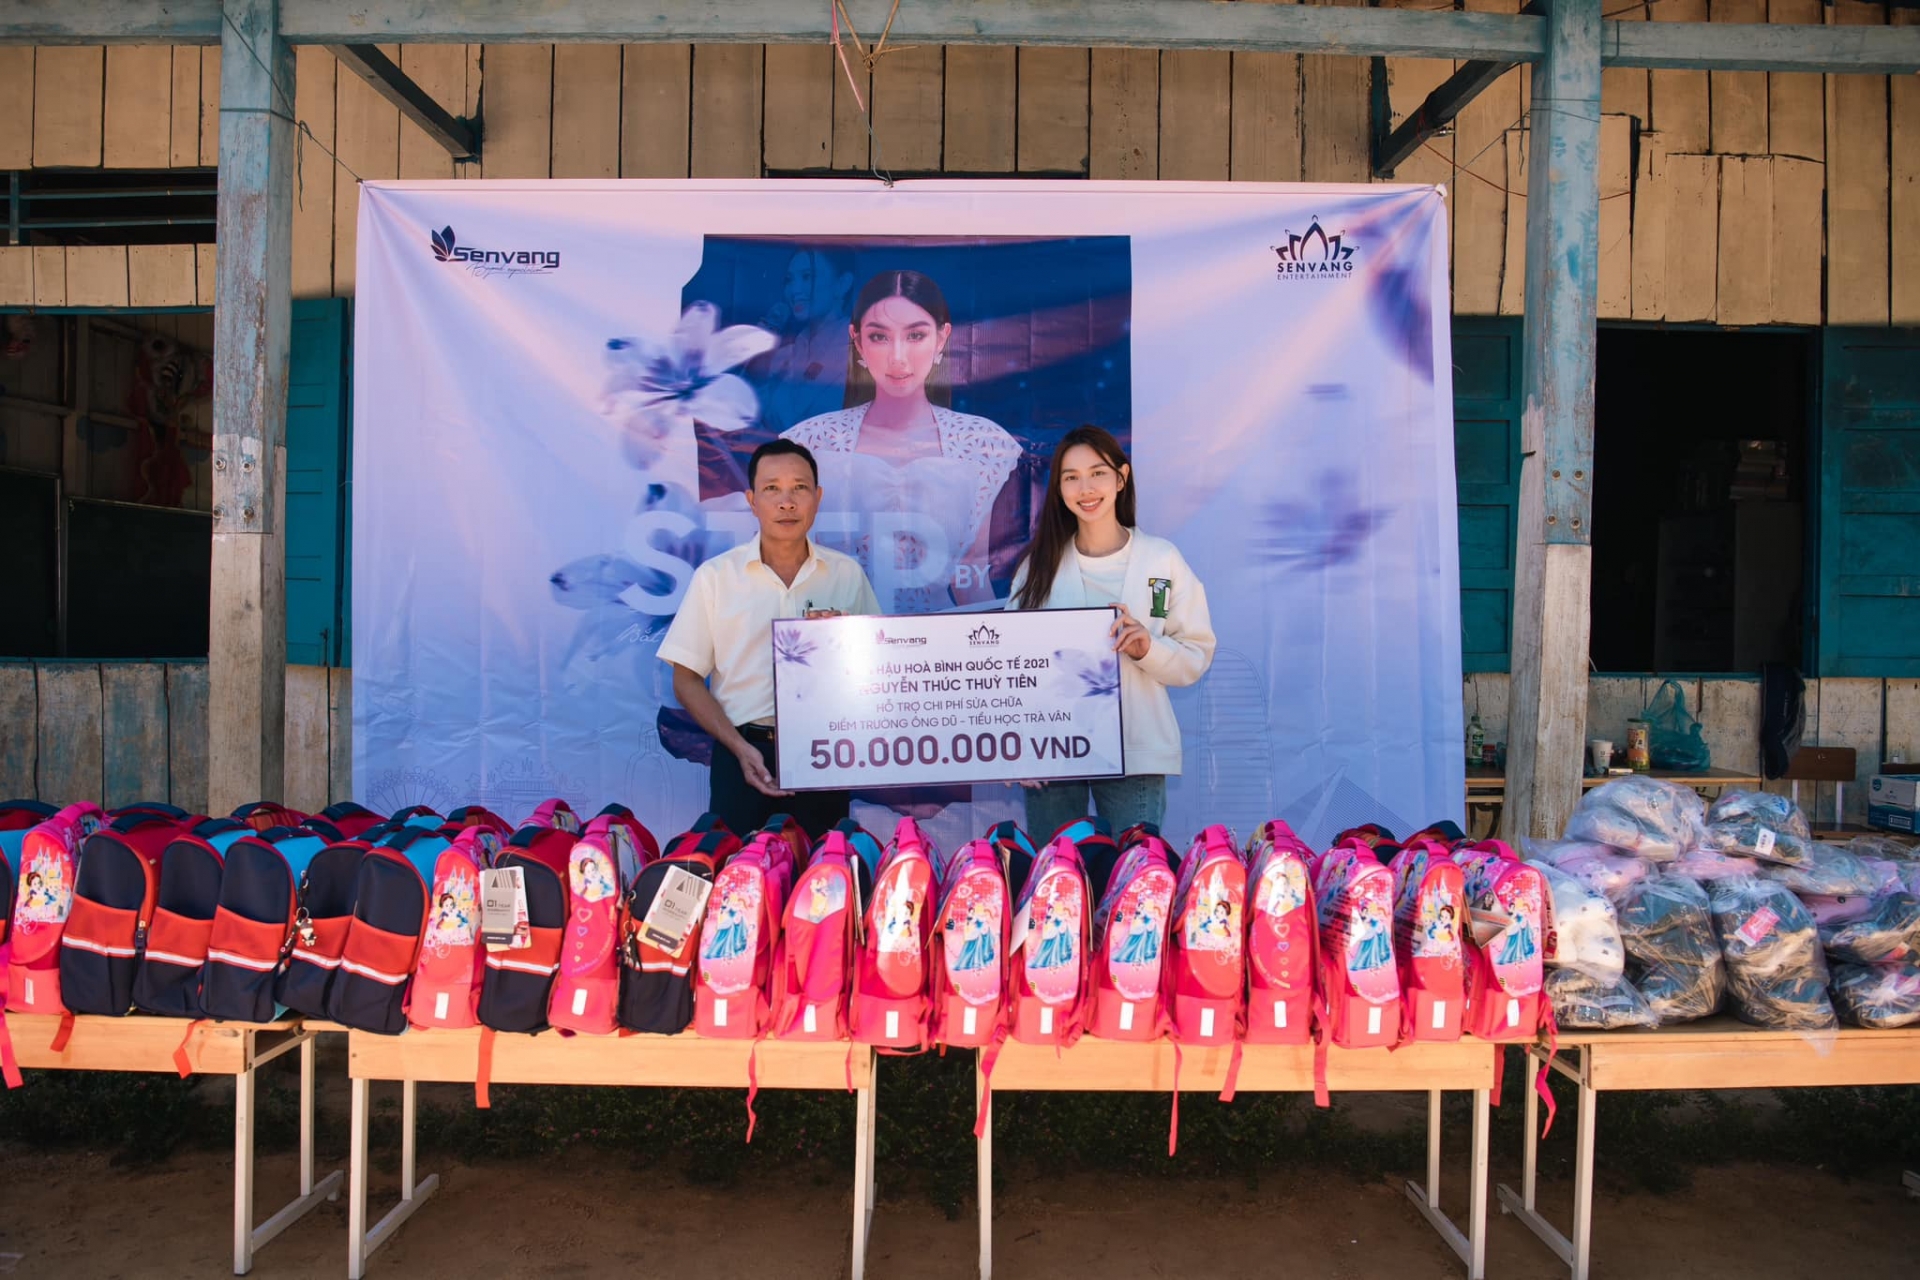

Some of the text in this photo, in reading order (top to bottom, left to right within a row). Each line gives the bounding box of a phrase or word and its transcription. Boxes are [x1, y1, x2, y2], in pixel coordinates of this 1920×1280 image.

[447, 247, 560, 268] Senvang
[1277, 261, 1353, 273] SENVANG
[1277, 272, 1352, 281] ENTERTAINMENT
[619, 510, 951, 616] SP
[954, 564, 991, 590] BY
[876, 661, 901, 678] HẬU
[904, 660, 931, 674] HOÀ
[934, 659, 962, 673] BÌNH
[965, 656, 1003, 672] QUỐC
[1006, 655, 1021, 669] TẾ
[1023, 658, 1050, 669] 2021
[922, 677, 961, 692] THÚC
[965, 675, 1002, 690] THUỲ
[1006, 673, 1037, 688] TIÊN
[897, 701, 921, 714] TRỢ
[923, 700, 943, 711] CHI
[945, 698, 964, 710] PHÍ
[990, 695, 1023, 708] CHỮA
[911, 715, 939, 728] ÔNG
[941, 714, 957, 726] DŨ
[968, 711, 992, 726] TIỂU
[994, 713, 1021, 726] HỌC
[1023, 711, 1046, 723] TRÀ
[810, 731, 1091, 770] 50.000.000 VND
